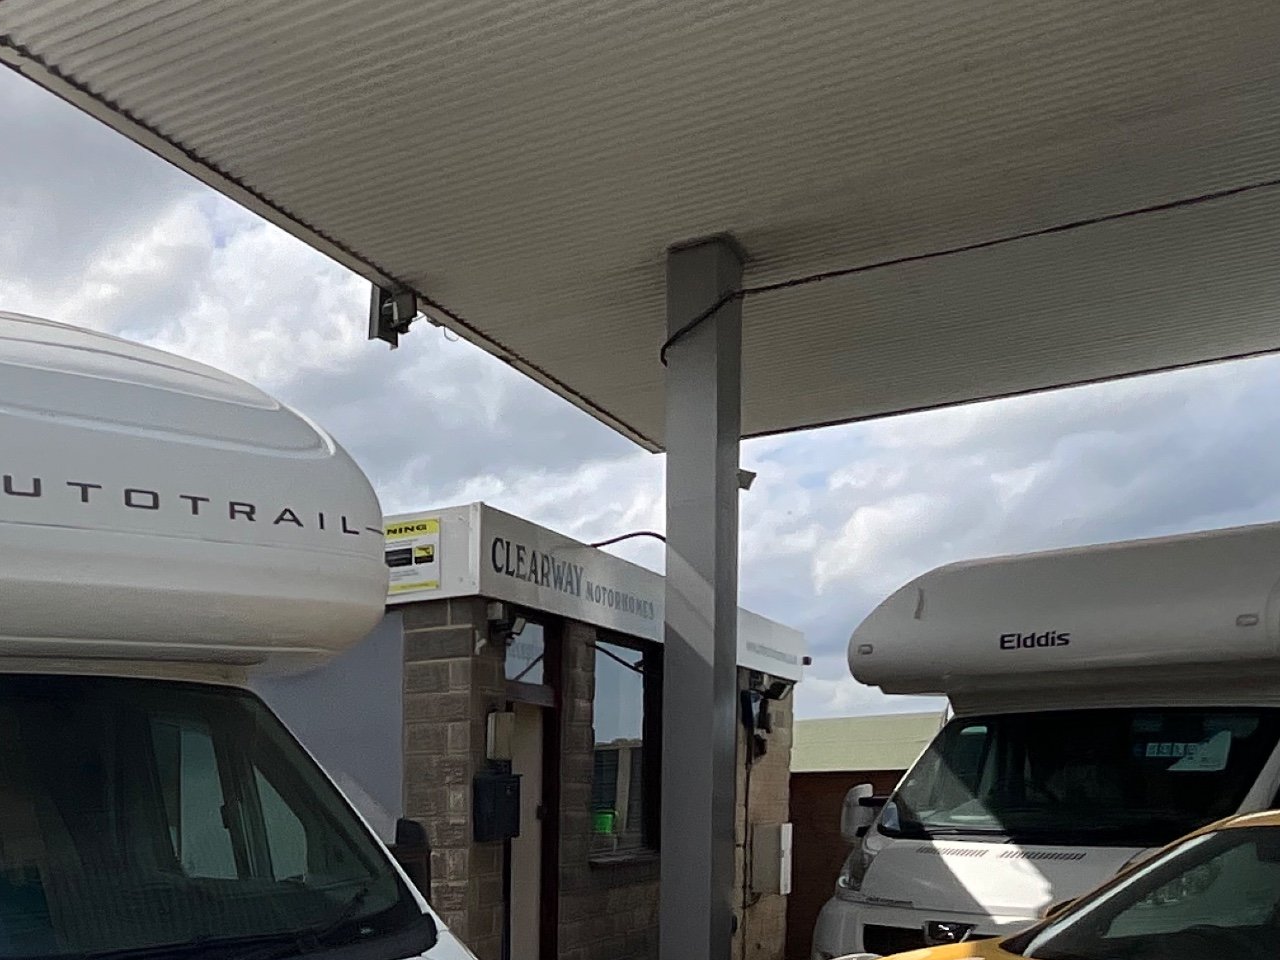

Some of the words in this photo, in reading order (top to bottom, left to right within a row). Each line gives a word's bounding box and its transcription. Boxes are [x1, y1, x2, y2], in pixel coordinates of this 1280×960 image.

[491, 537, 584, 597] CLEARWAY
[586, 580, 655, 621] MOTORHOMES
[999, 630, 1071, 650] Elddis
